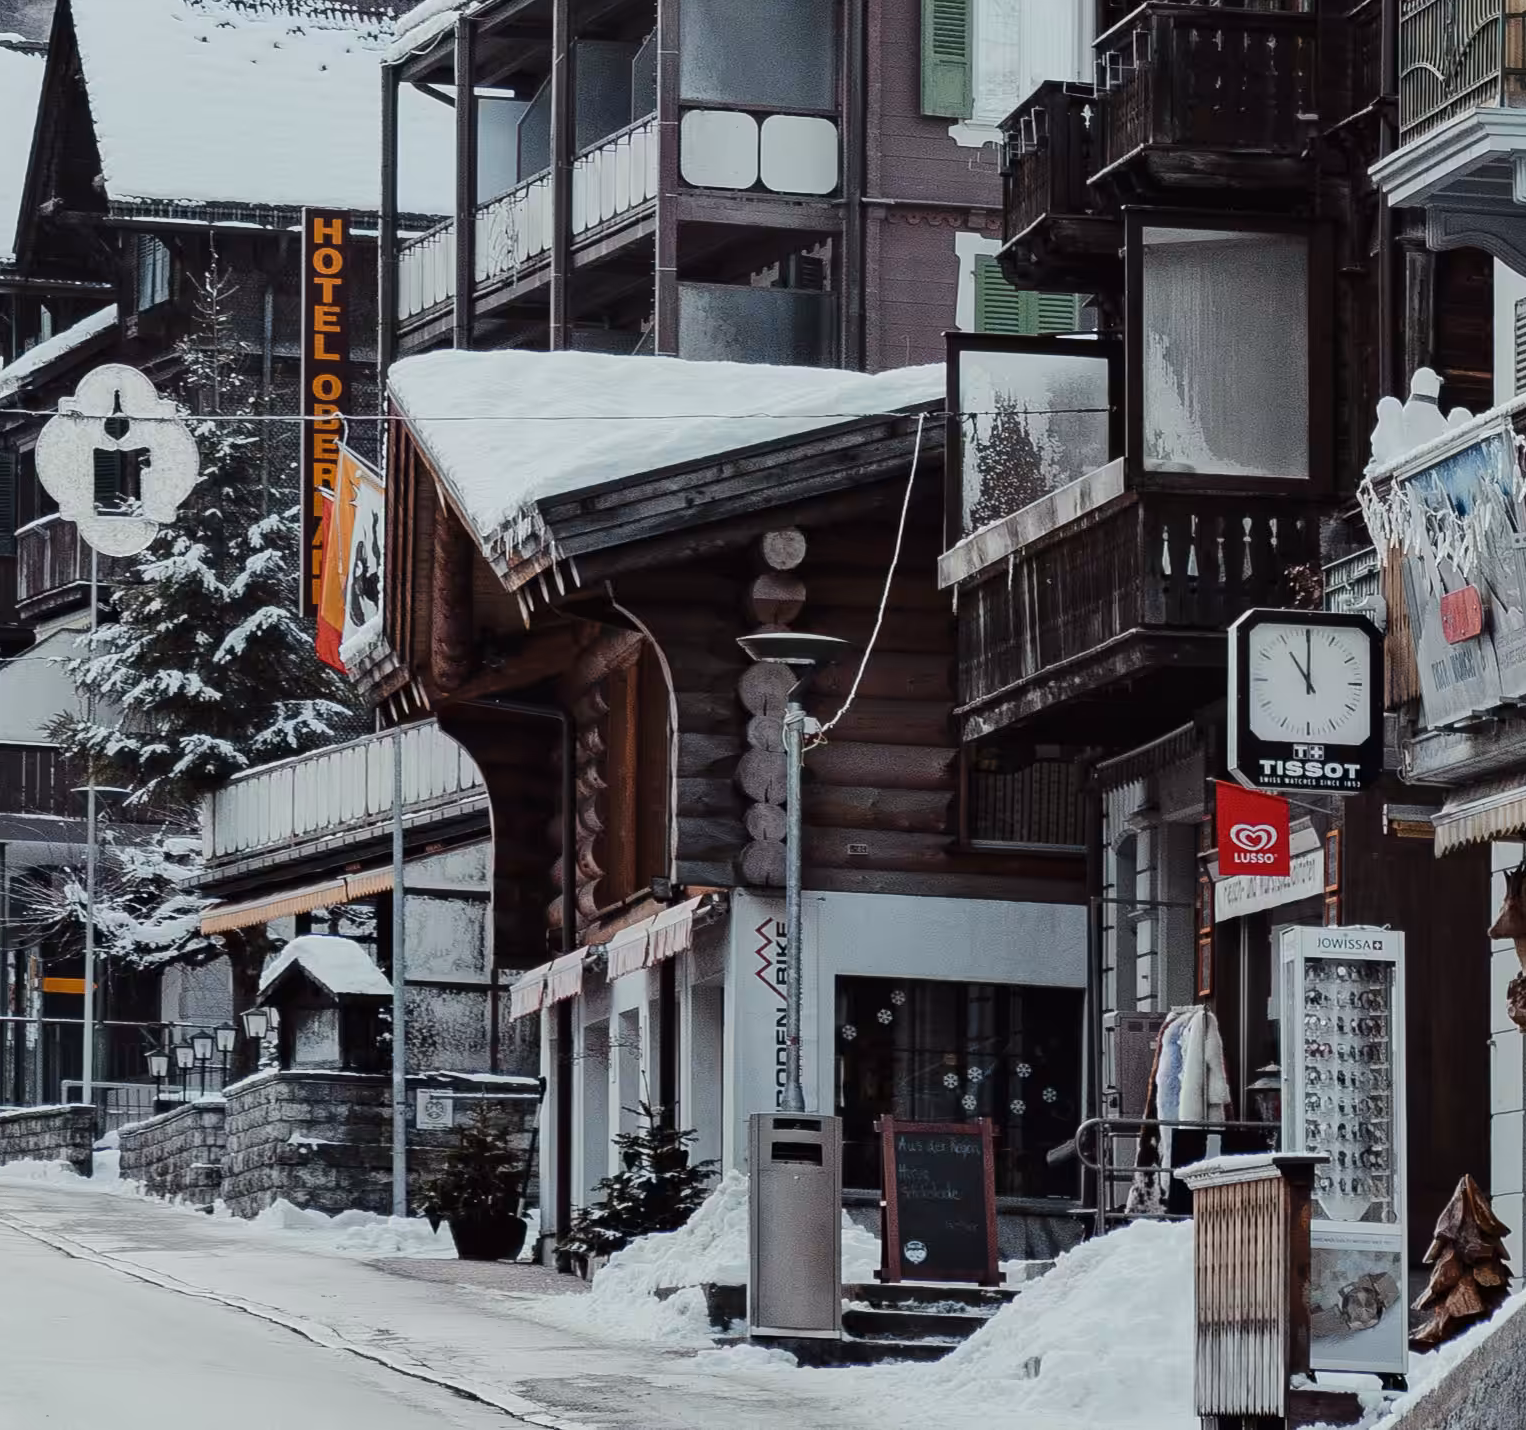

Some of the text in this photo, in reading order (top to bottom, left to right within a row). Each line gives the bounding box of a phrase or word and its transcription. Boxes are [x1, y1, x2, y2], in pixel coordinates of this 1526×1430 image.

[313, 218, 343, 361] HOTEL
[1259, 760, 1360, 779] TISSOT
[1259, 776, 1281, 784] SWISS
[1234, 853, 1275, 863] LUSSO
[1317, 938, 1371, 950] JOWISSA
